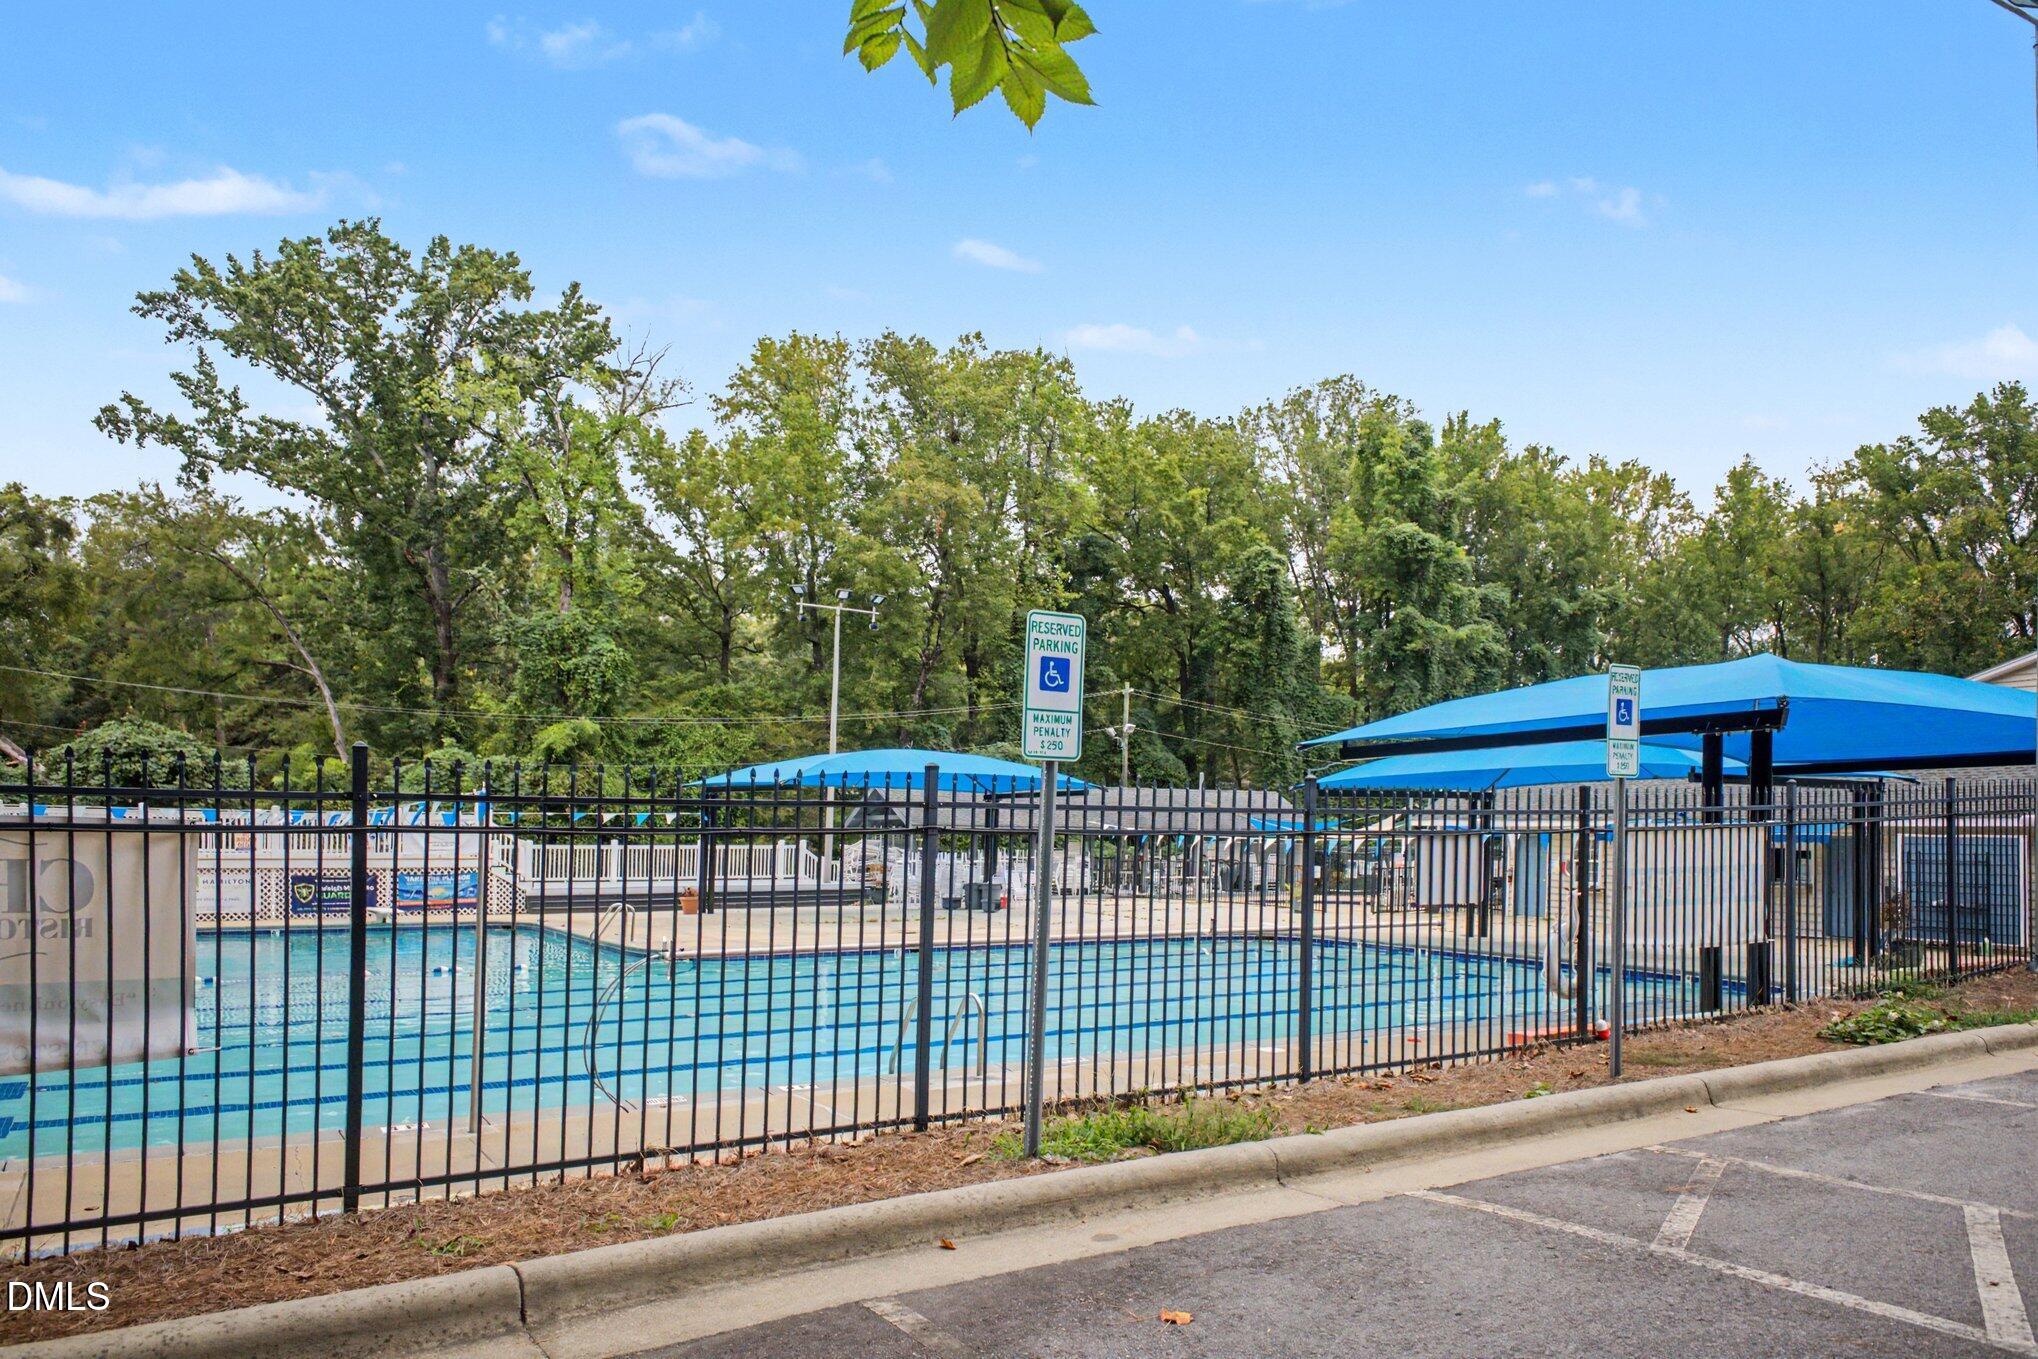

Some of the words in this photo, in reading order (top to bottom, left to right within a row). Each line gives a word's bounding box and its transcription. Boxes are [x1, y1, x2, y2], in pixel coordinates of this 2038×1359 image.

[1031, 620, 1082, 637] RESERVED
[1033, 637, 1078, 654] PARKING
[1611, 671, 1639, 683] RESERVED
[1612, 685, 1637, 696] PARKING
[1033, 713, 1073, 725] MAXIMUM
[1033, 726, 1072, 738] PENALTY
[1040, 740, 1064, 751] $250
